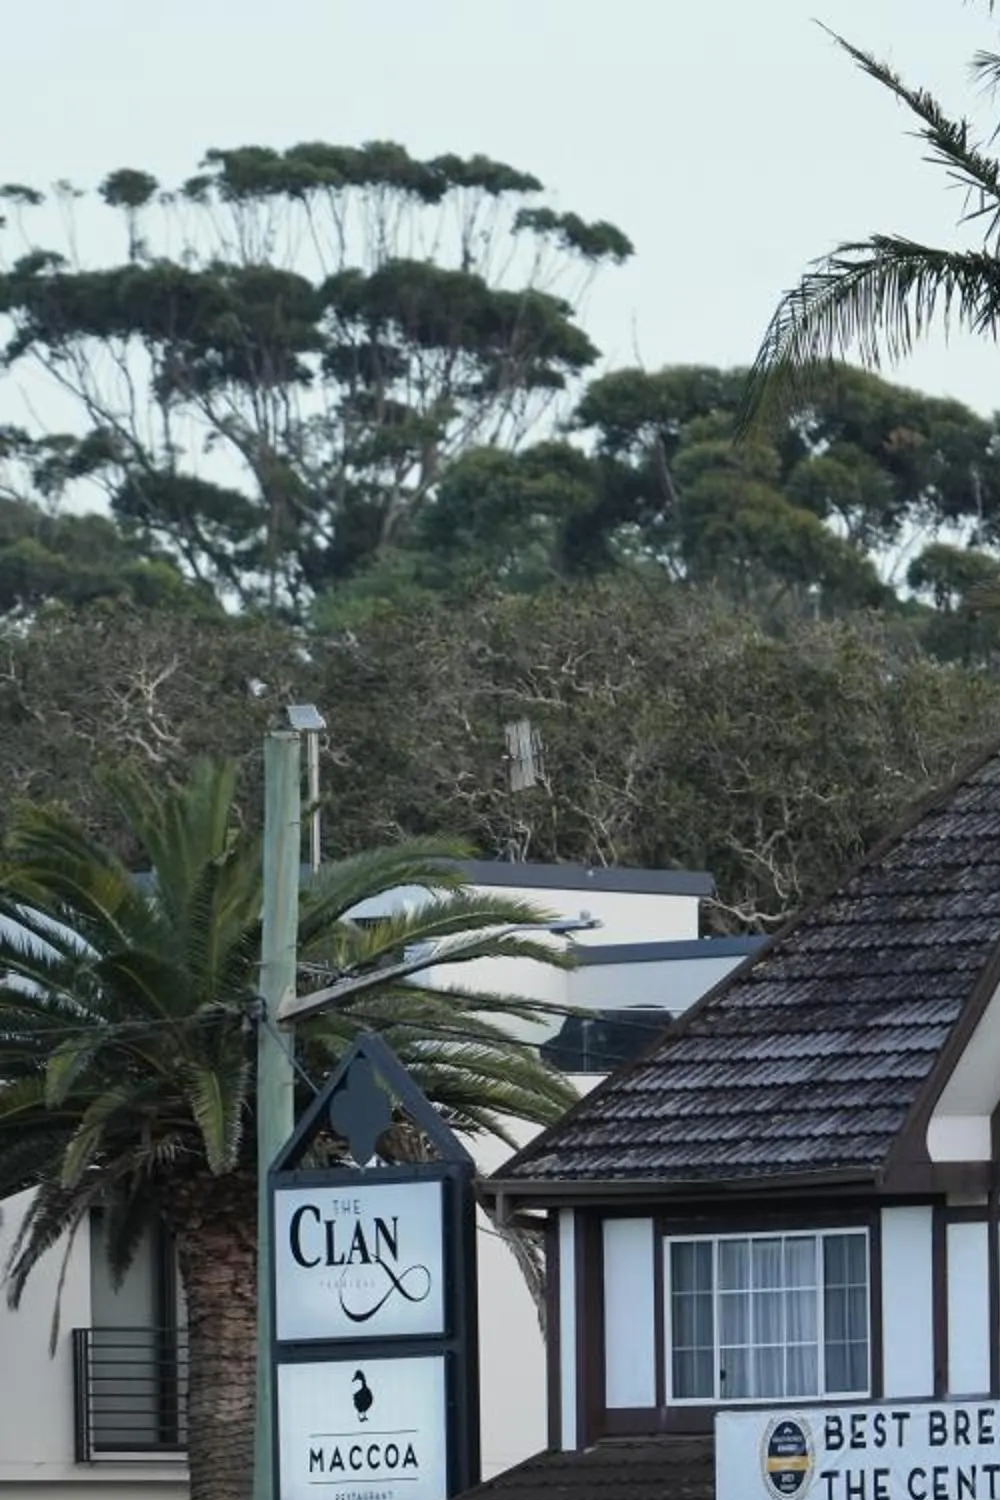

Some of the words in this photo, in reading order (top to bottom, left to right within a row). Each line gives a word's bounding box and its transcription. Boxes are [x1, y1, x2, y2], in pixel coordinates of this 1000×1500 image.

[332, 1199, 361, 1215] THE
[289, 1204, 399, 1268] CLAN
[825, 1411, 911, 1451] BEST
[309, 1443, 419, 1473] MACCOA
